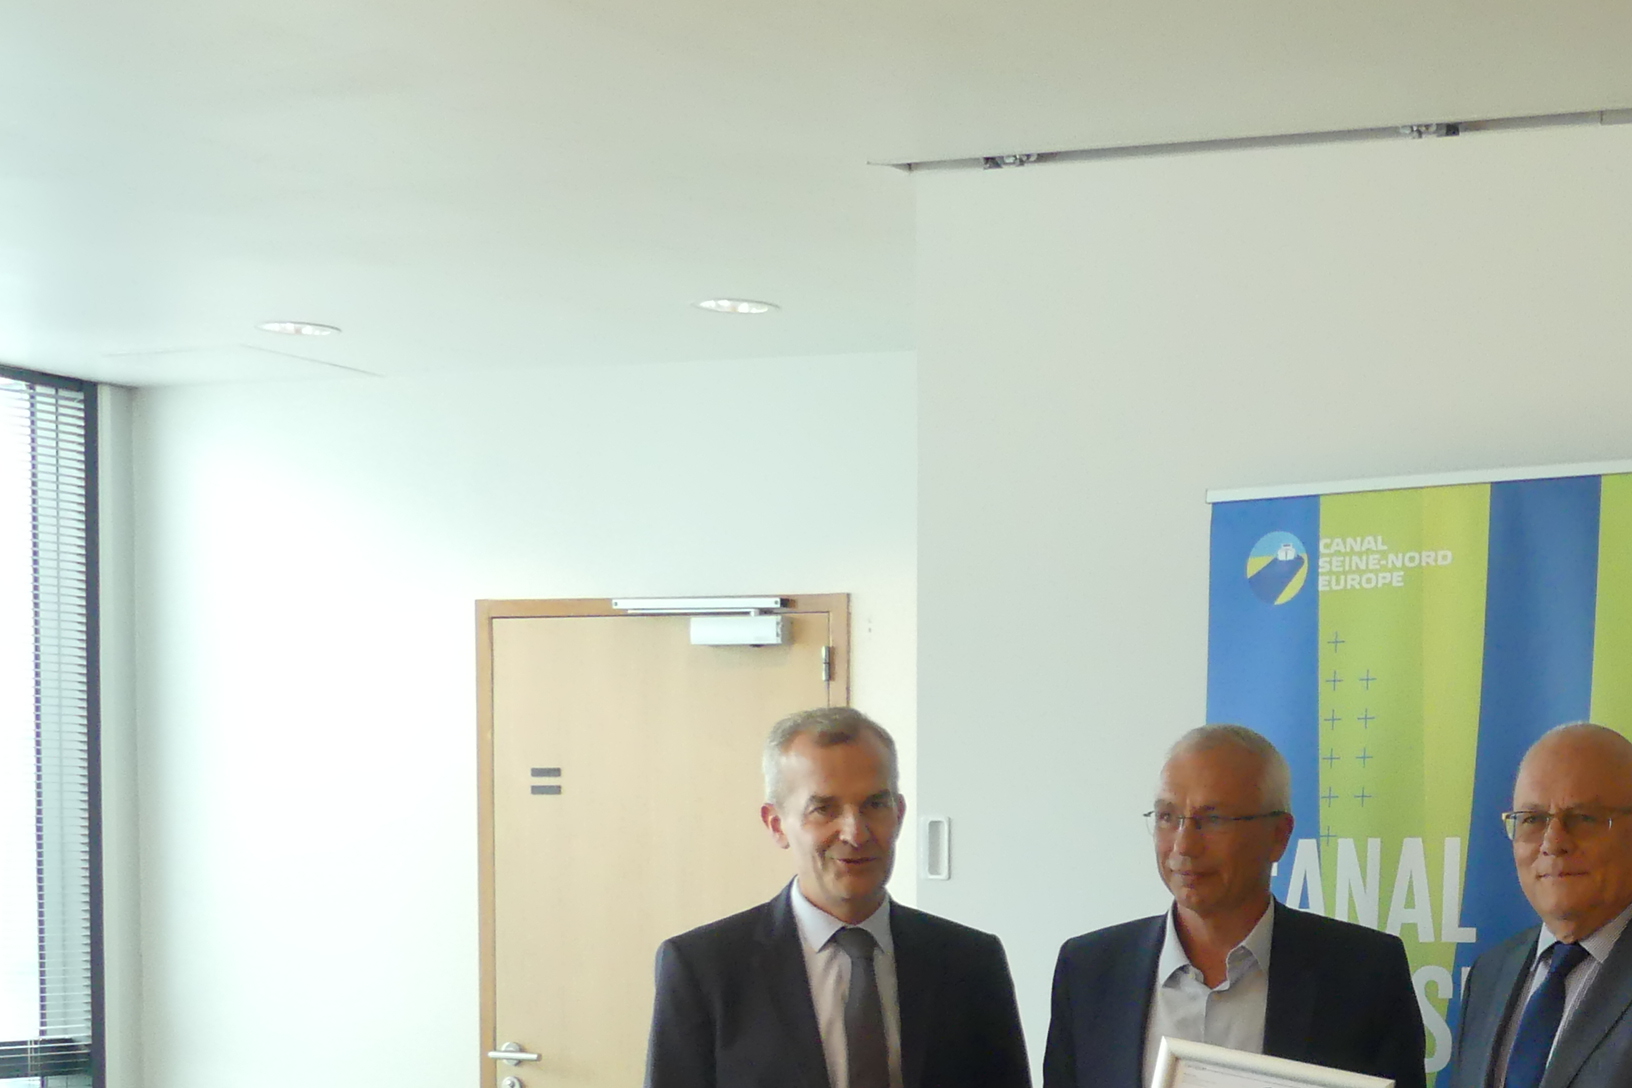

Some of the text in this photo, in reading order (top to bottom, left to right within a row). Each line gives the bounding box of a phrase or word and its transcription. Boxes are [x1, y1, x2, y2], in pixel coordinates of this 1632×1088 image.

[1319, 535, 1388, 554] CANAL
[1318, 550, 1453, 572] SEINE-NORD
[1318, 571, 1404, 591] EUROPE
[1271, 837, 1477, 943] ANAL
